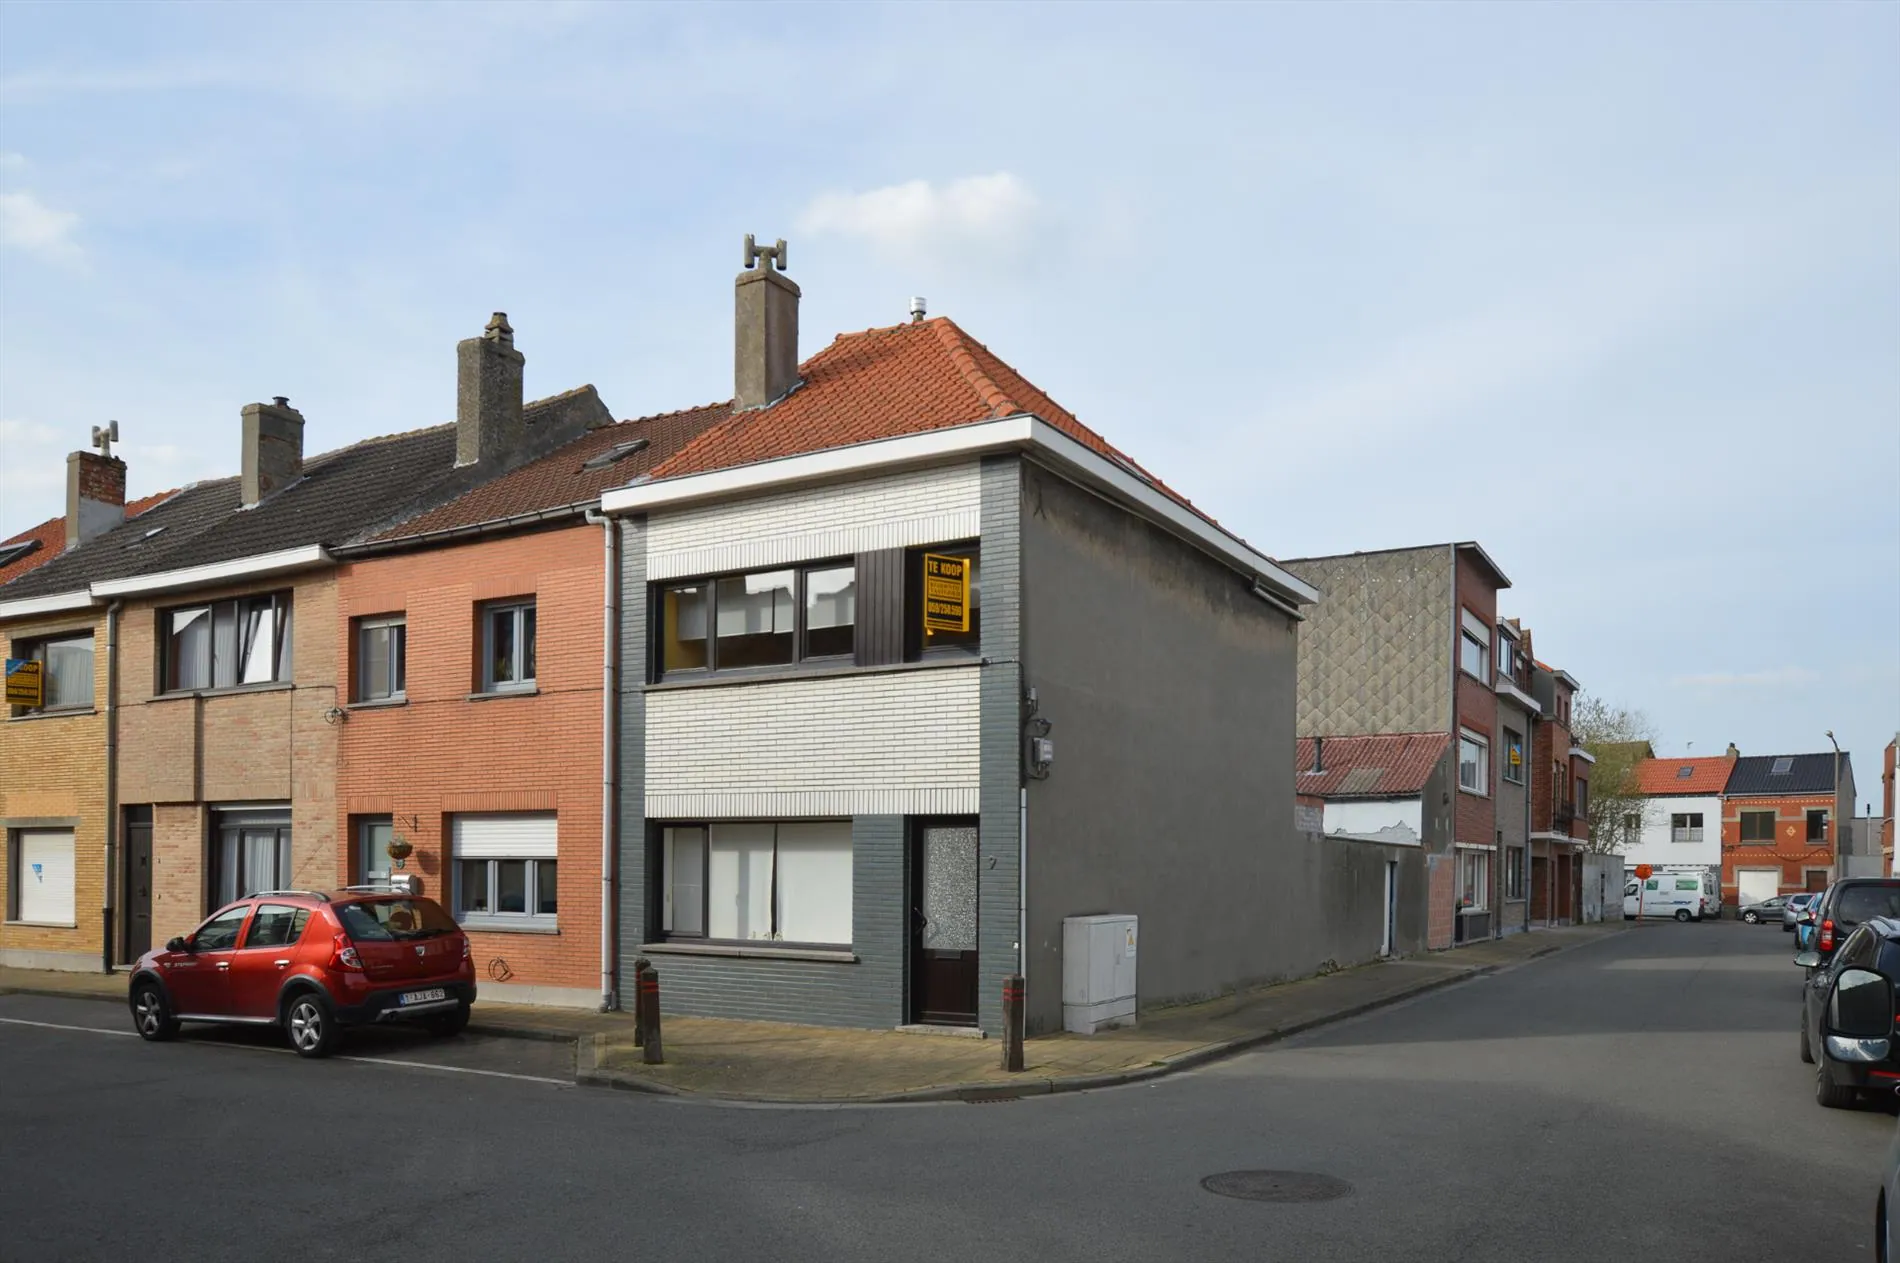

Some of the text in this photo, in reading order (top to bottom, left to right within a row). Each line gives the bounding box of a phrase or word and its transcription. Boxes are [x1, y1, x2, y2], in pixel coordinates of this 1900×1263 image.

[928, 560, 962, 576] TE KOOP
[990, 857, 997, 870] 7
